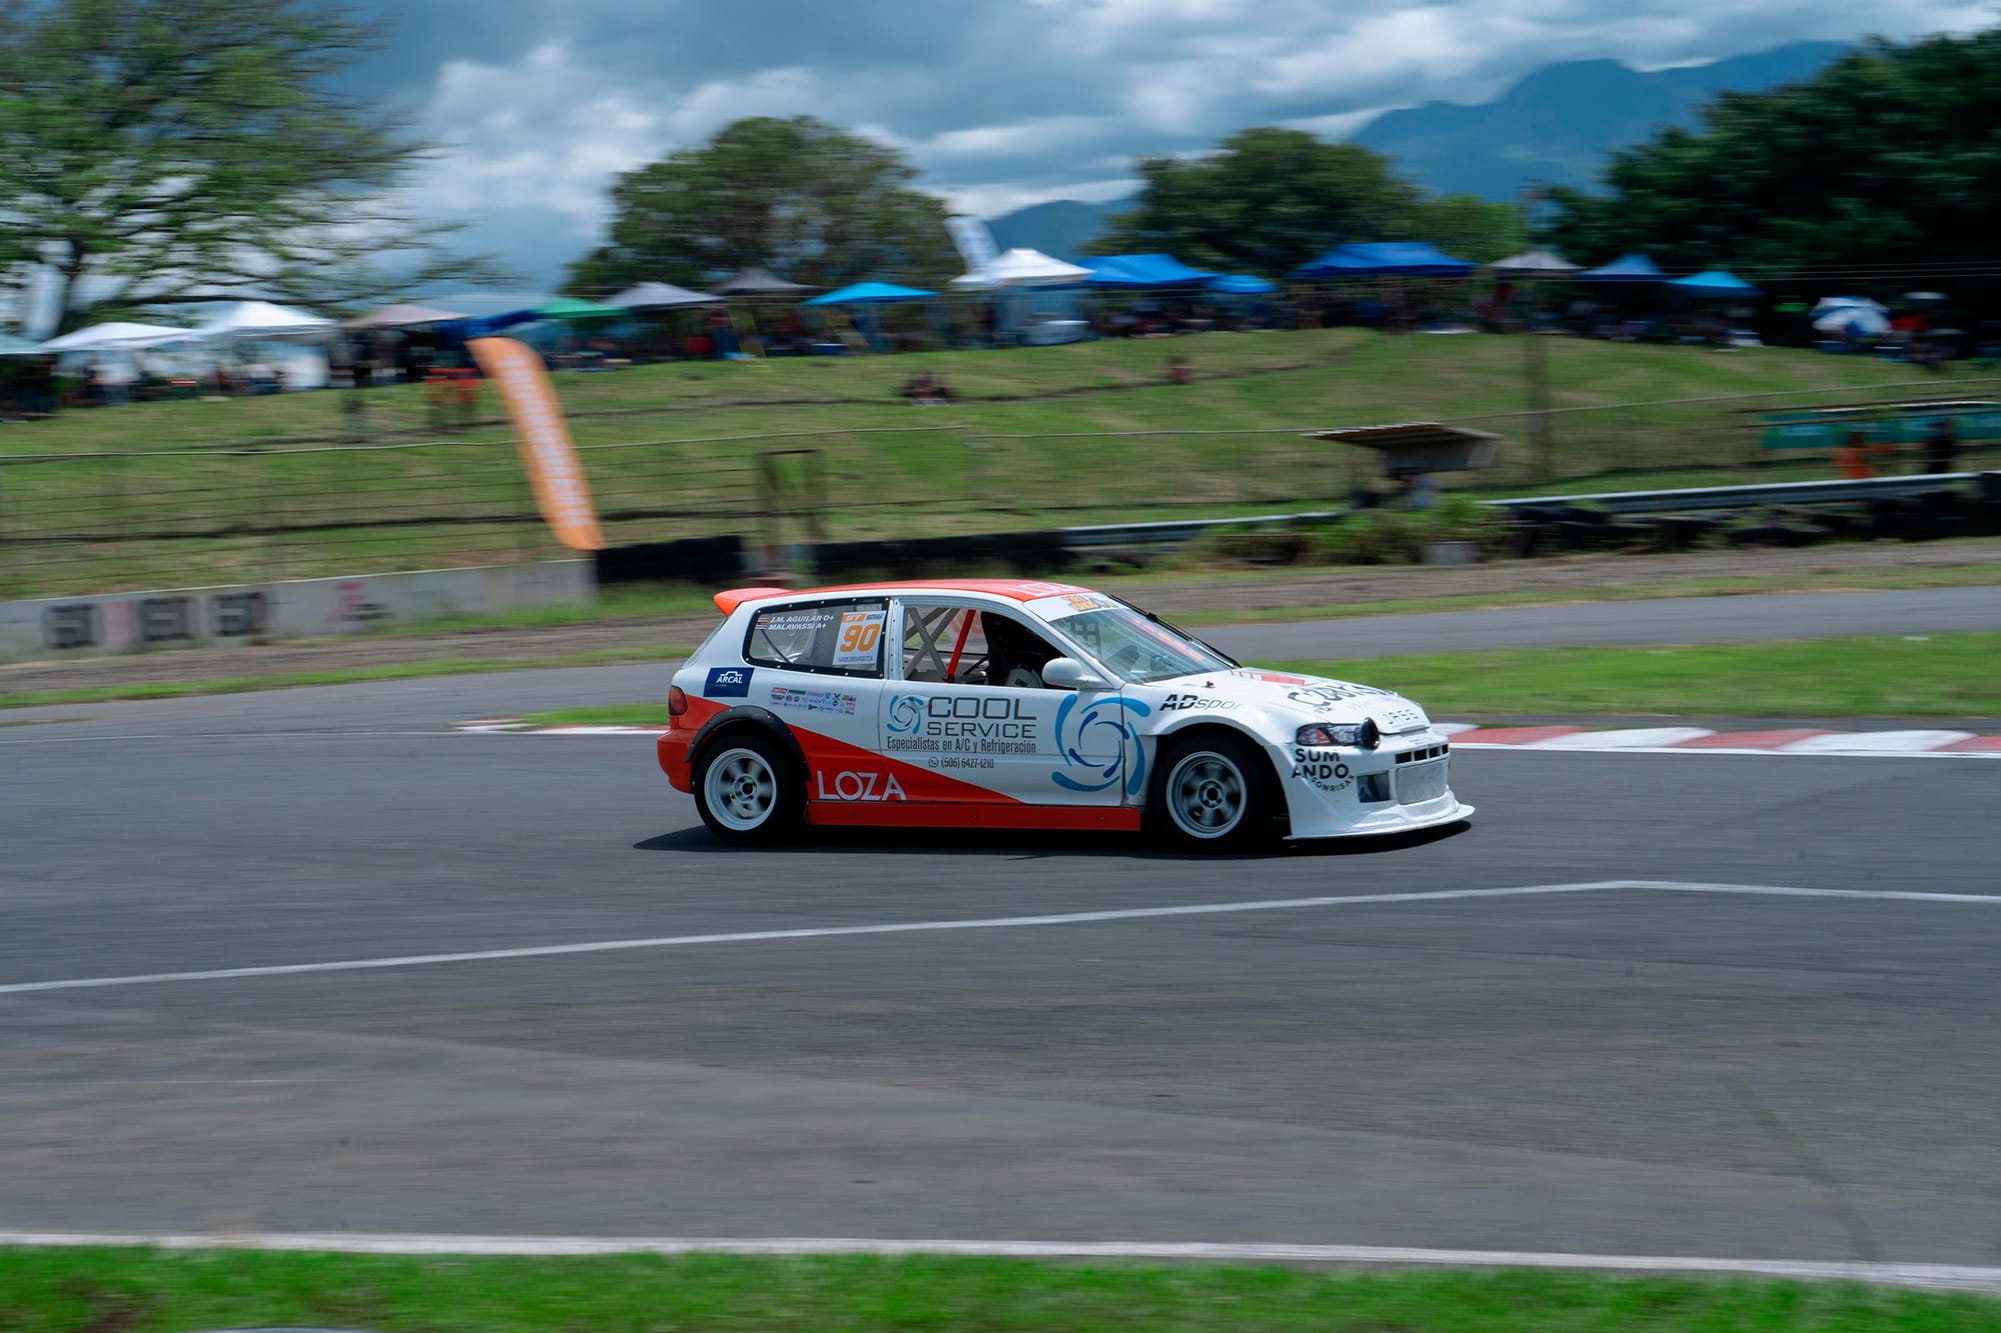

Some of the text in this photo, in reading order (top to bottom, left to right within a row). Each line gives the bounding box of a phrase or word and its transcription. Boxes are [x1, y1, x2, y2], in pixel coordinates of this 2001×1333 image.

[840, 623, 880, 652] 90
[716, 676, 743, 684] ARCAL
[928, 696, 1037, 720] COOL
[926, 721, 1037, 739] SERVICE
[887, 736, 1037, 754] Especialistas en A/C y Refrigeración
[1295, 748, 1340, 762] SUM
[1291, 763, 1349, 779] ANDO
[817, 770, 907, 801] LOZA
